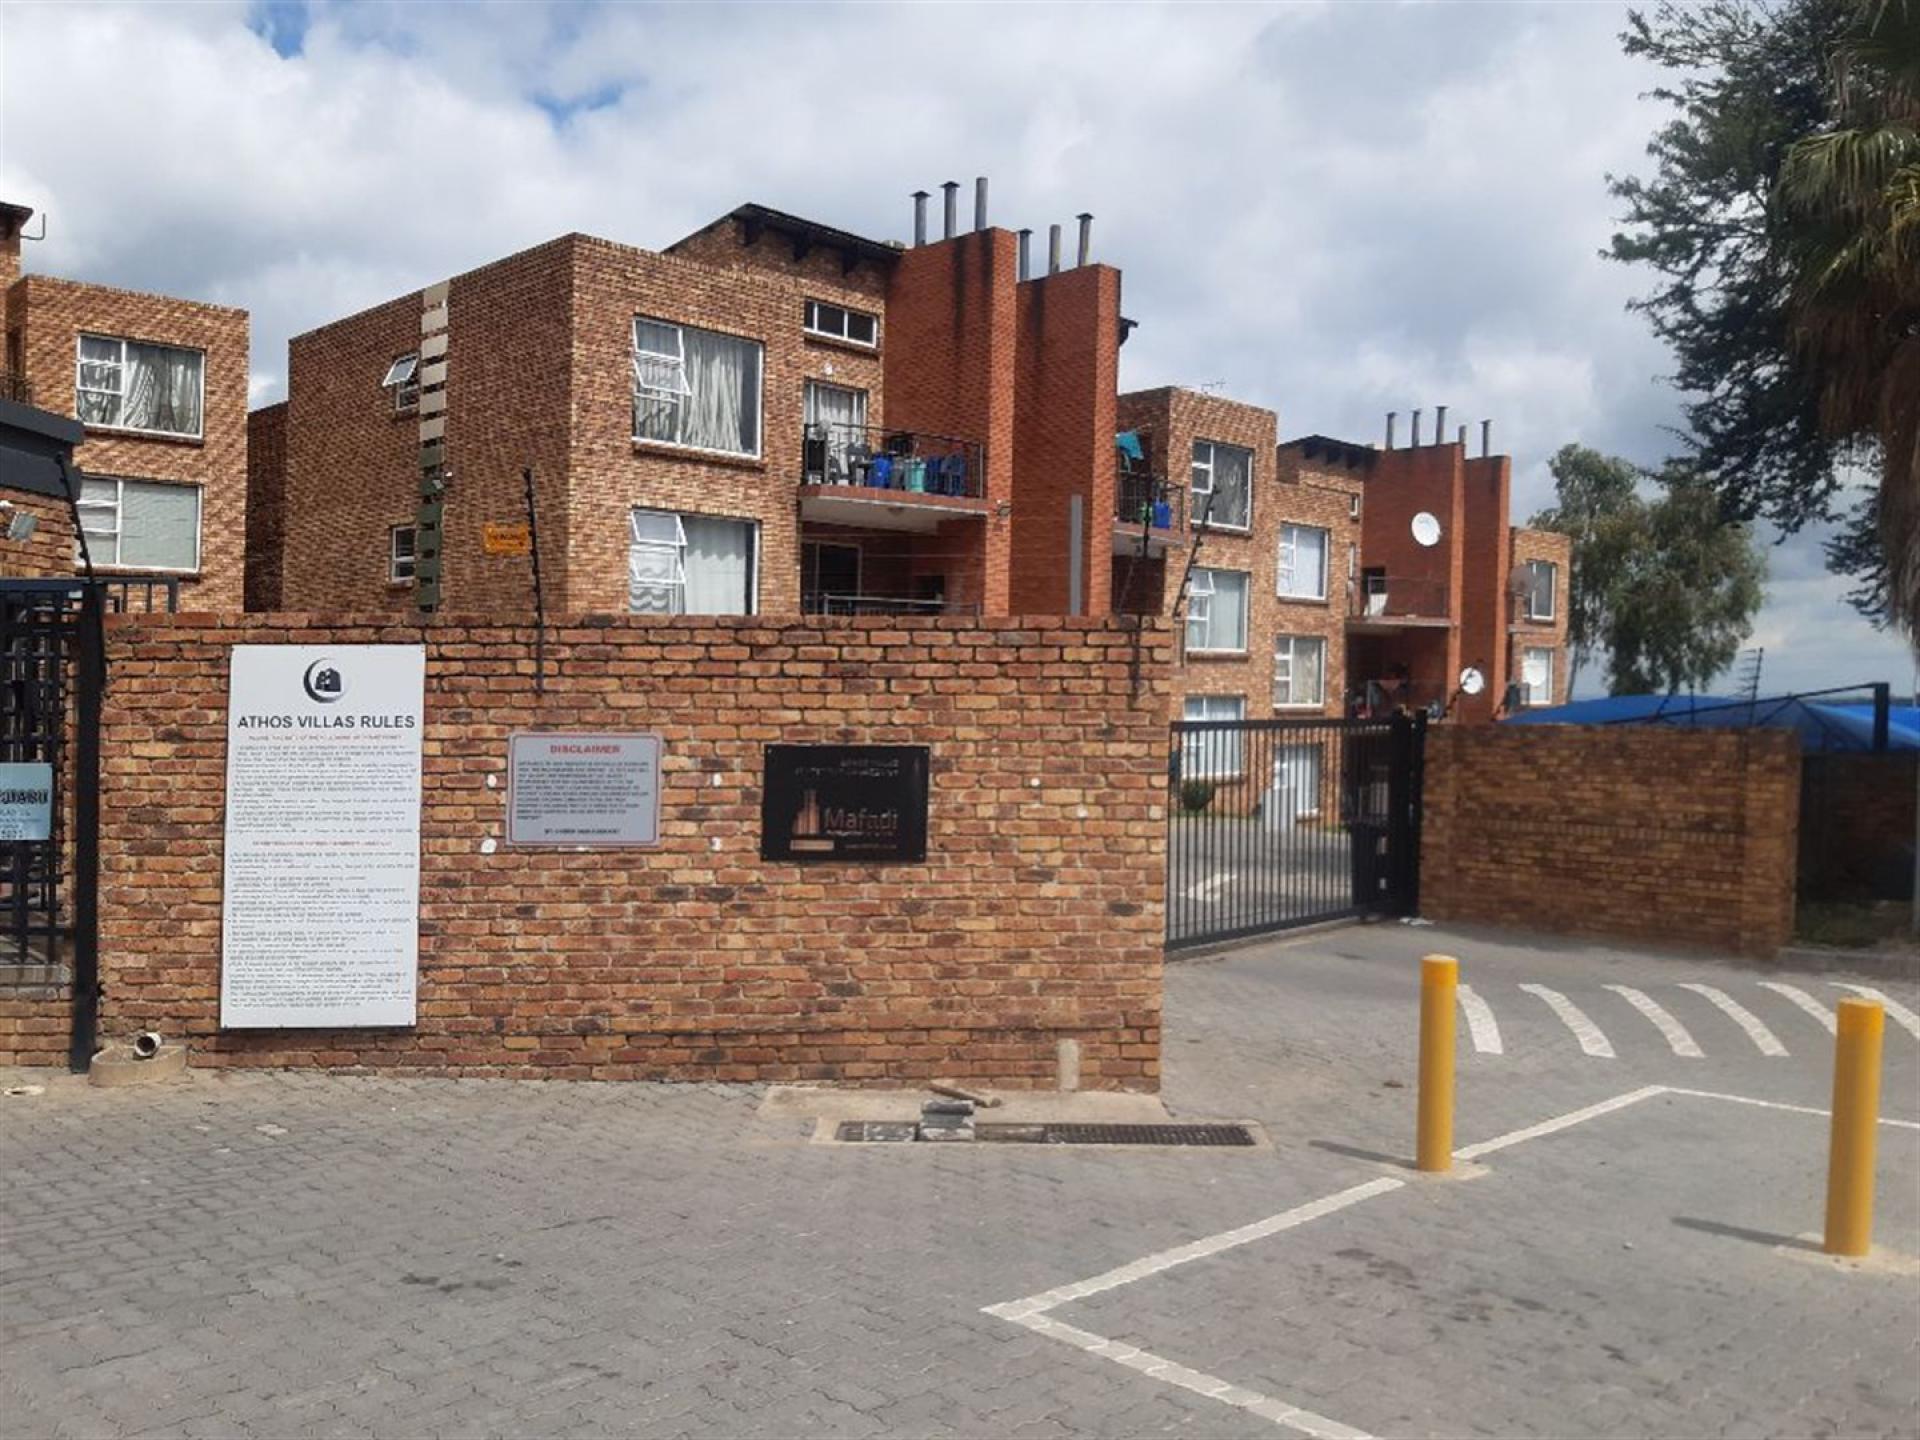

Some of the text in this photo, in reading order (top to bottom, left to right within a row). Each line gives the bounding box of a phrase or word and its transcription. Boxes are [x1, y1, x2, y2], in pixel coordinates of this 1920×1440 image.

[237, 715, 415, 729] ATHOS VILLAS RULES
[549, 744, 621, 754] DISCLAIMER
